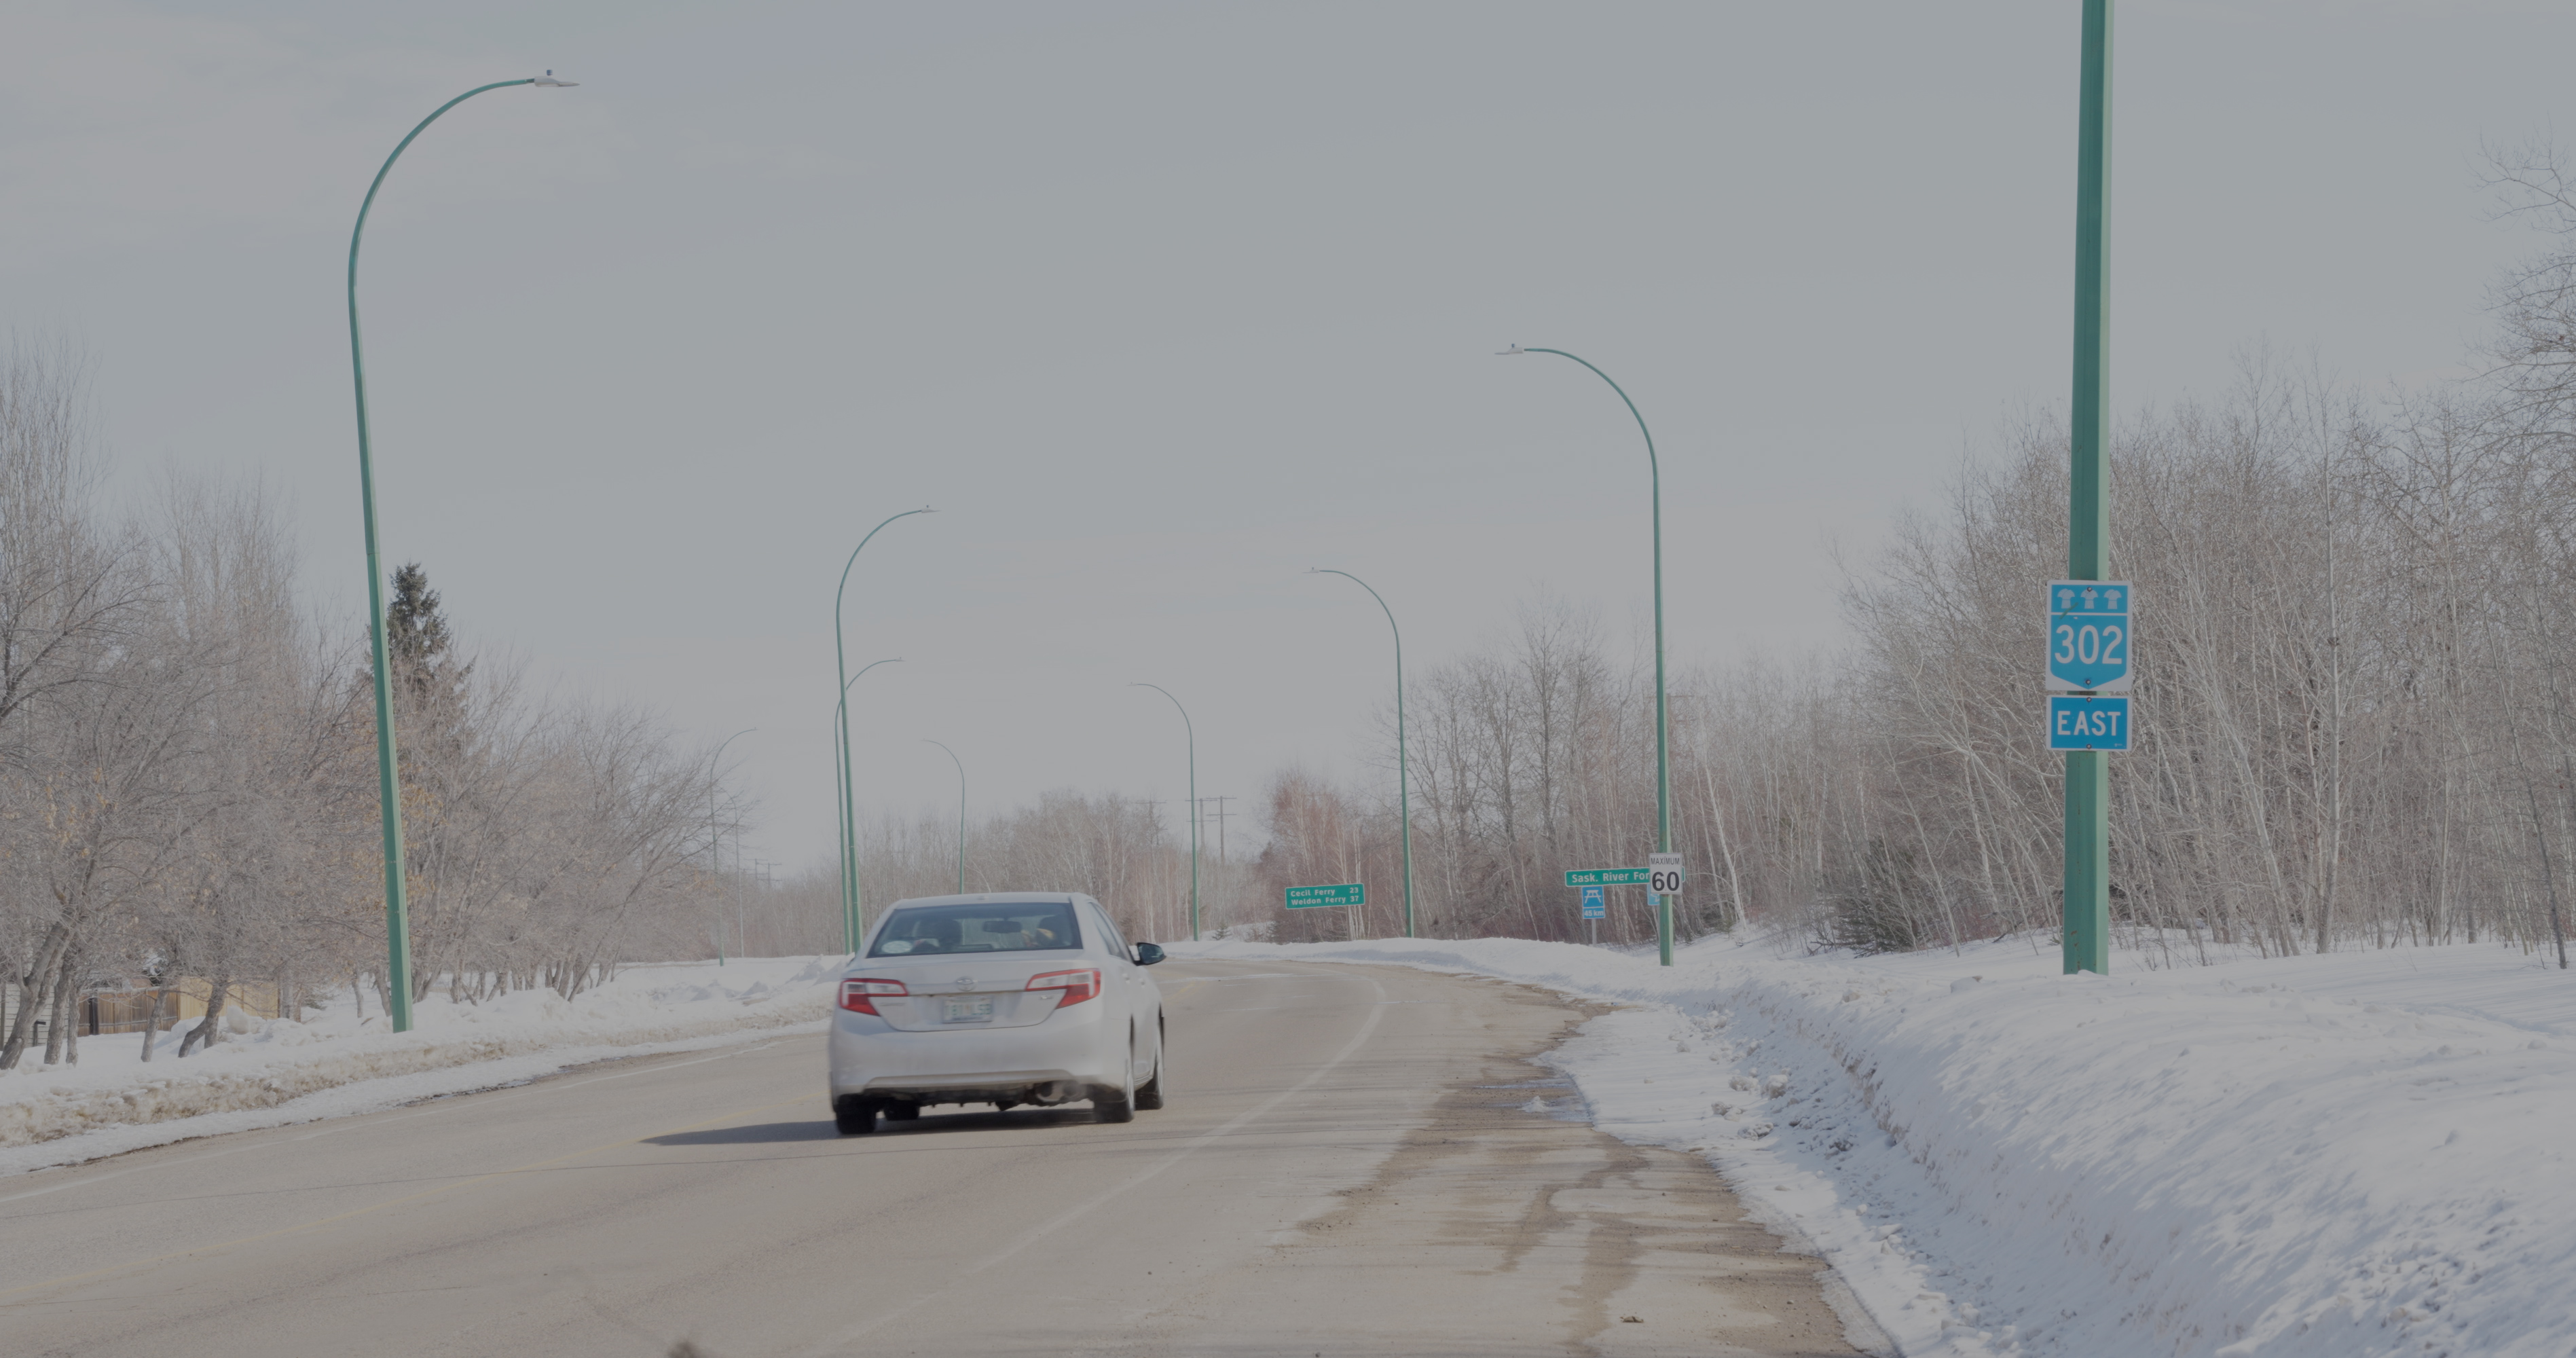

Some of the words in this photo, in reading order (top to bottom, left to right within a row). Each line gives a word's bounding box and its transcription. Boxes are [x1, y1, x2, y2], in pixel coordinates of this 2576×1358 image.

[2055, 624, 2122, 664] 302
[2057, 710, 2121, 736] EAST
[1572, 873, 1598, 883] Sask.
[1603, 872, 1629, 881] River
[1652, 871, 1680, 892] 60
